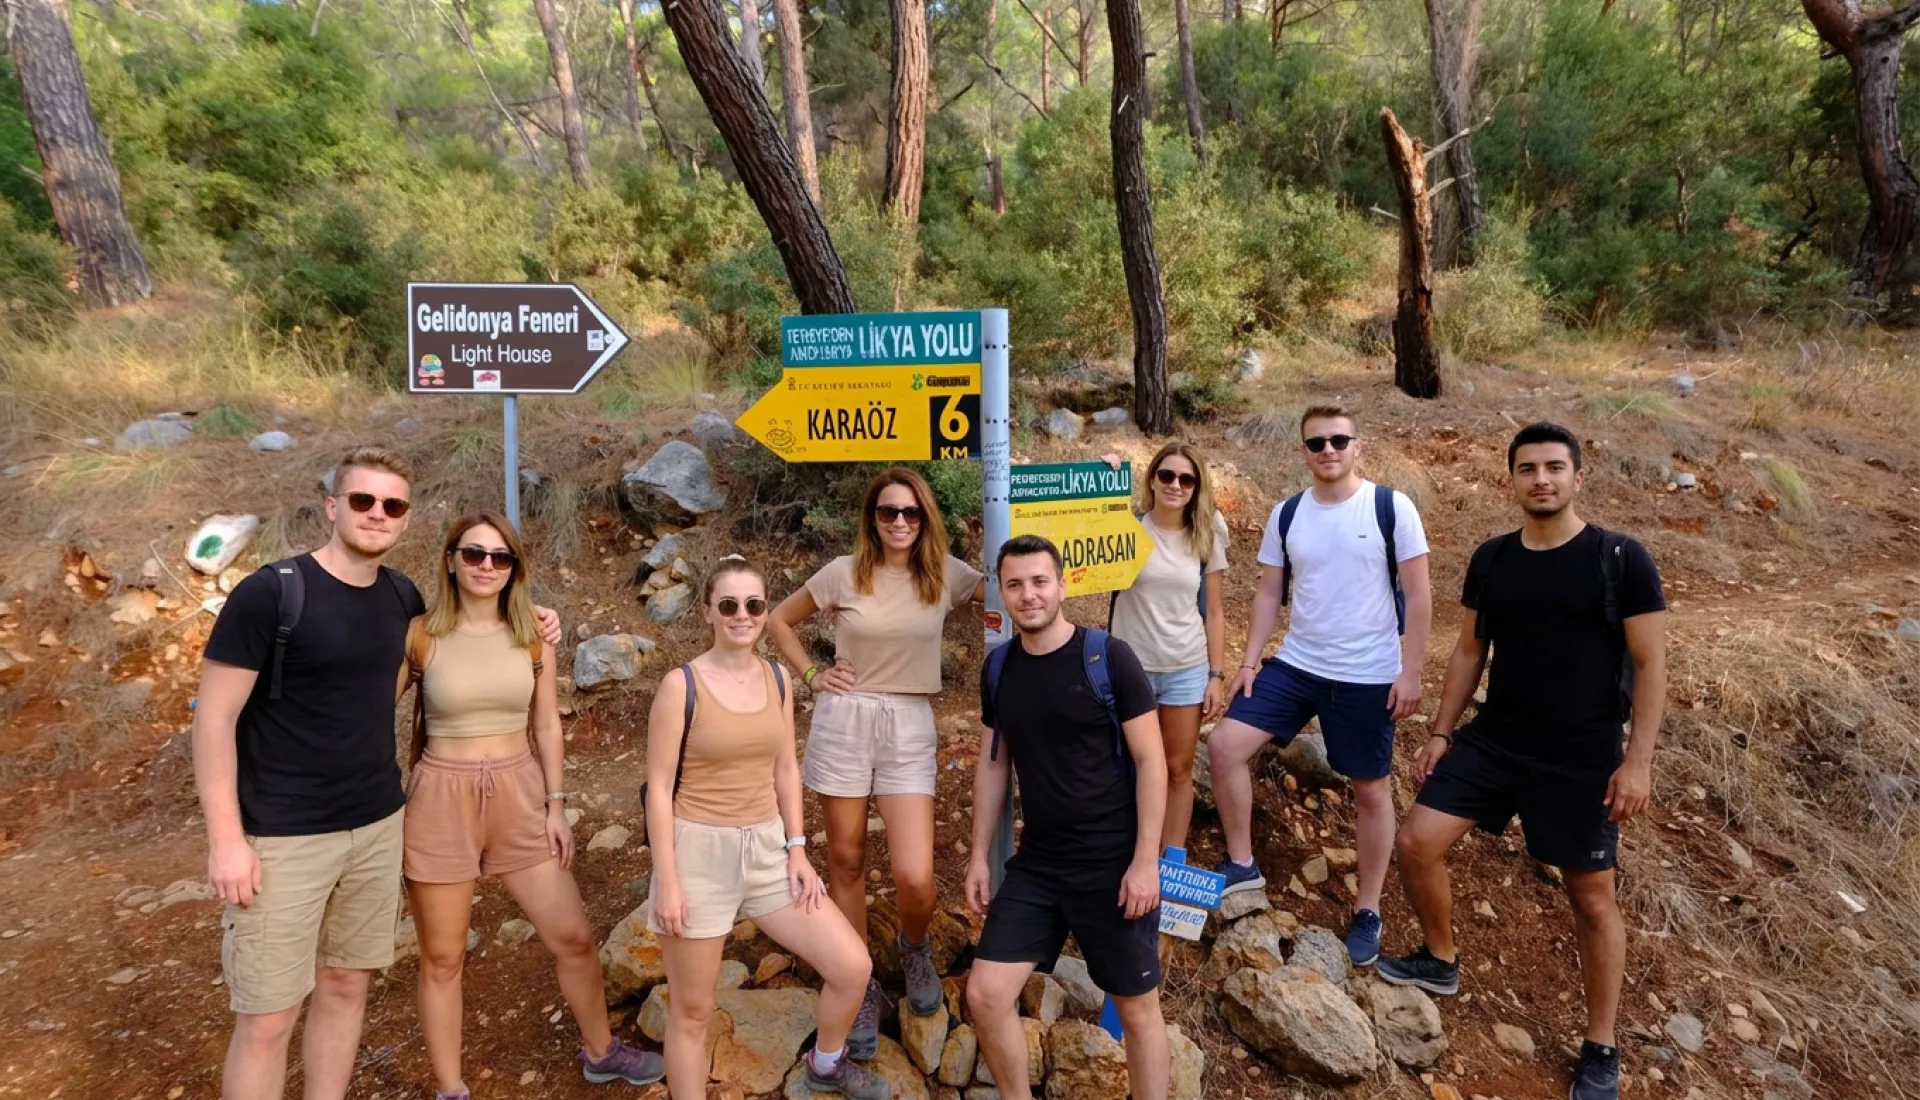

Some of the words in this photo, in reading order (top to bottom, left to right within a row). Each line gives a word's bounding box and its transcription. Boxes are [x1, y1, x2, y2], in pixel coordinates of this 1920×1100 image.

[417, 303, 513, 340] Gelidonya
[518, 304, 579, 333] Feneri
[858, 320, 916, 358] LİKYA
[921, 322, 974, 357] YOLU
[451, 344, 493, 367] Light
[497, 344, 552, 364] House
[807, 401, 898, 440] KARAÖZ
[939, 393, 970, 442] 6
[940, 446, 968, 460] KM
[1062, 468, 1097, 495] LİKYA
[1098, 469, 1129, 492] YOLU
[1062, 532, 1136, 568] ADRASAN
